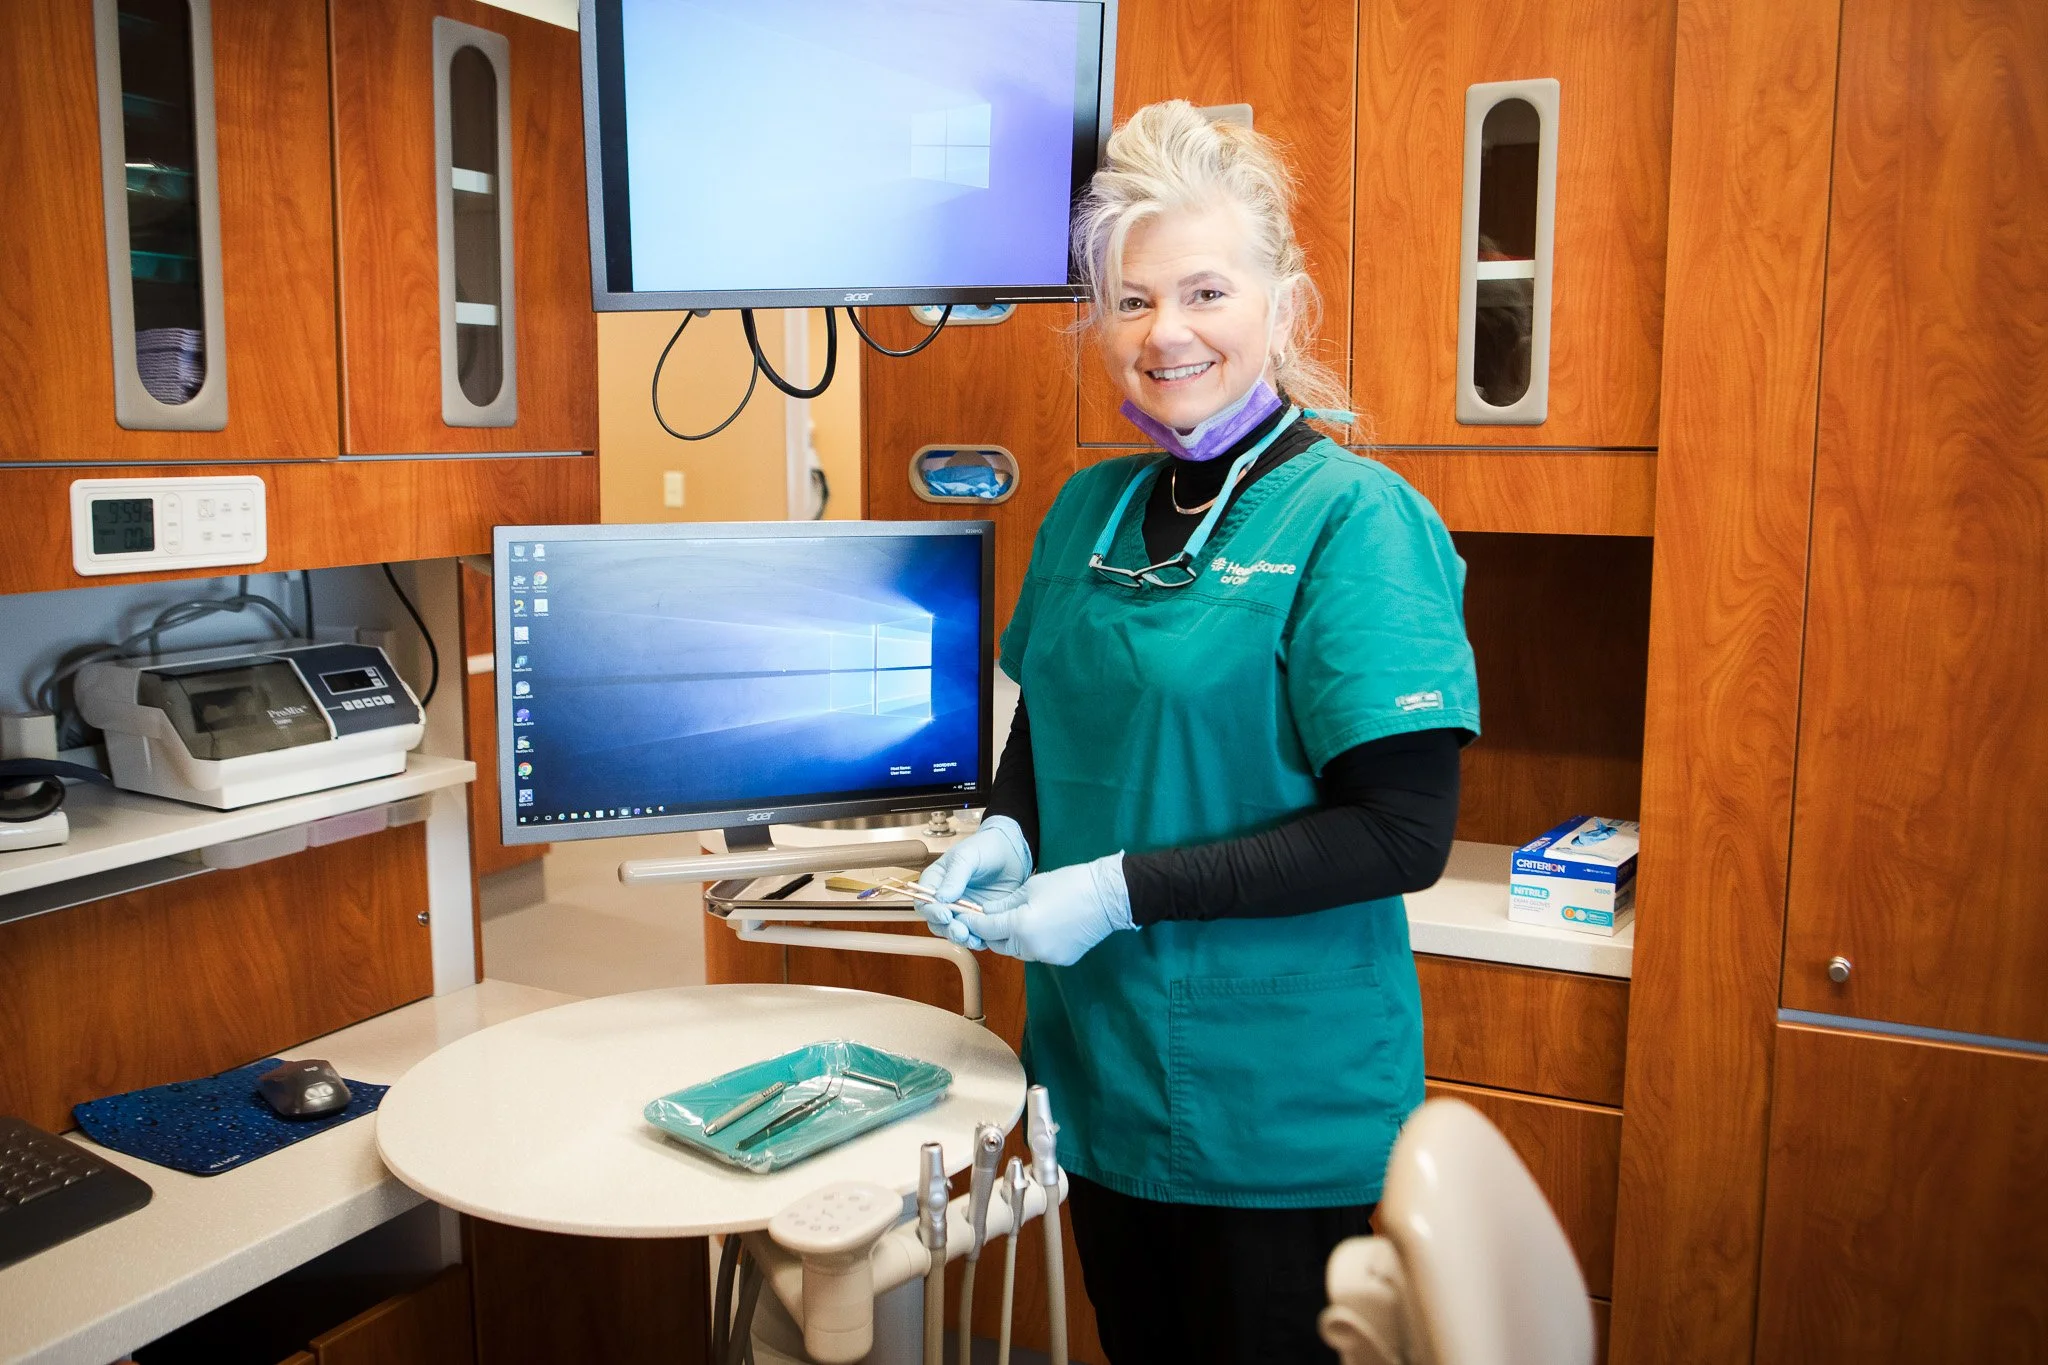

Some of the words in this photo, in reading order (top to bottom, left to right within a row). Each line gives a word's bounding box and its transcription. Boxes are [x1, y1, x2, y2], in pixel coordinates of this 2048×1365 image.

[844, 292, 874, 302] acer
[746, 811, 775, 822] acer
[1516, 858, 1566, 874] CRITERION
[1513, 886, 1549, 899] NITRILE
